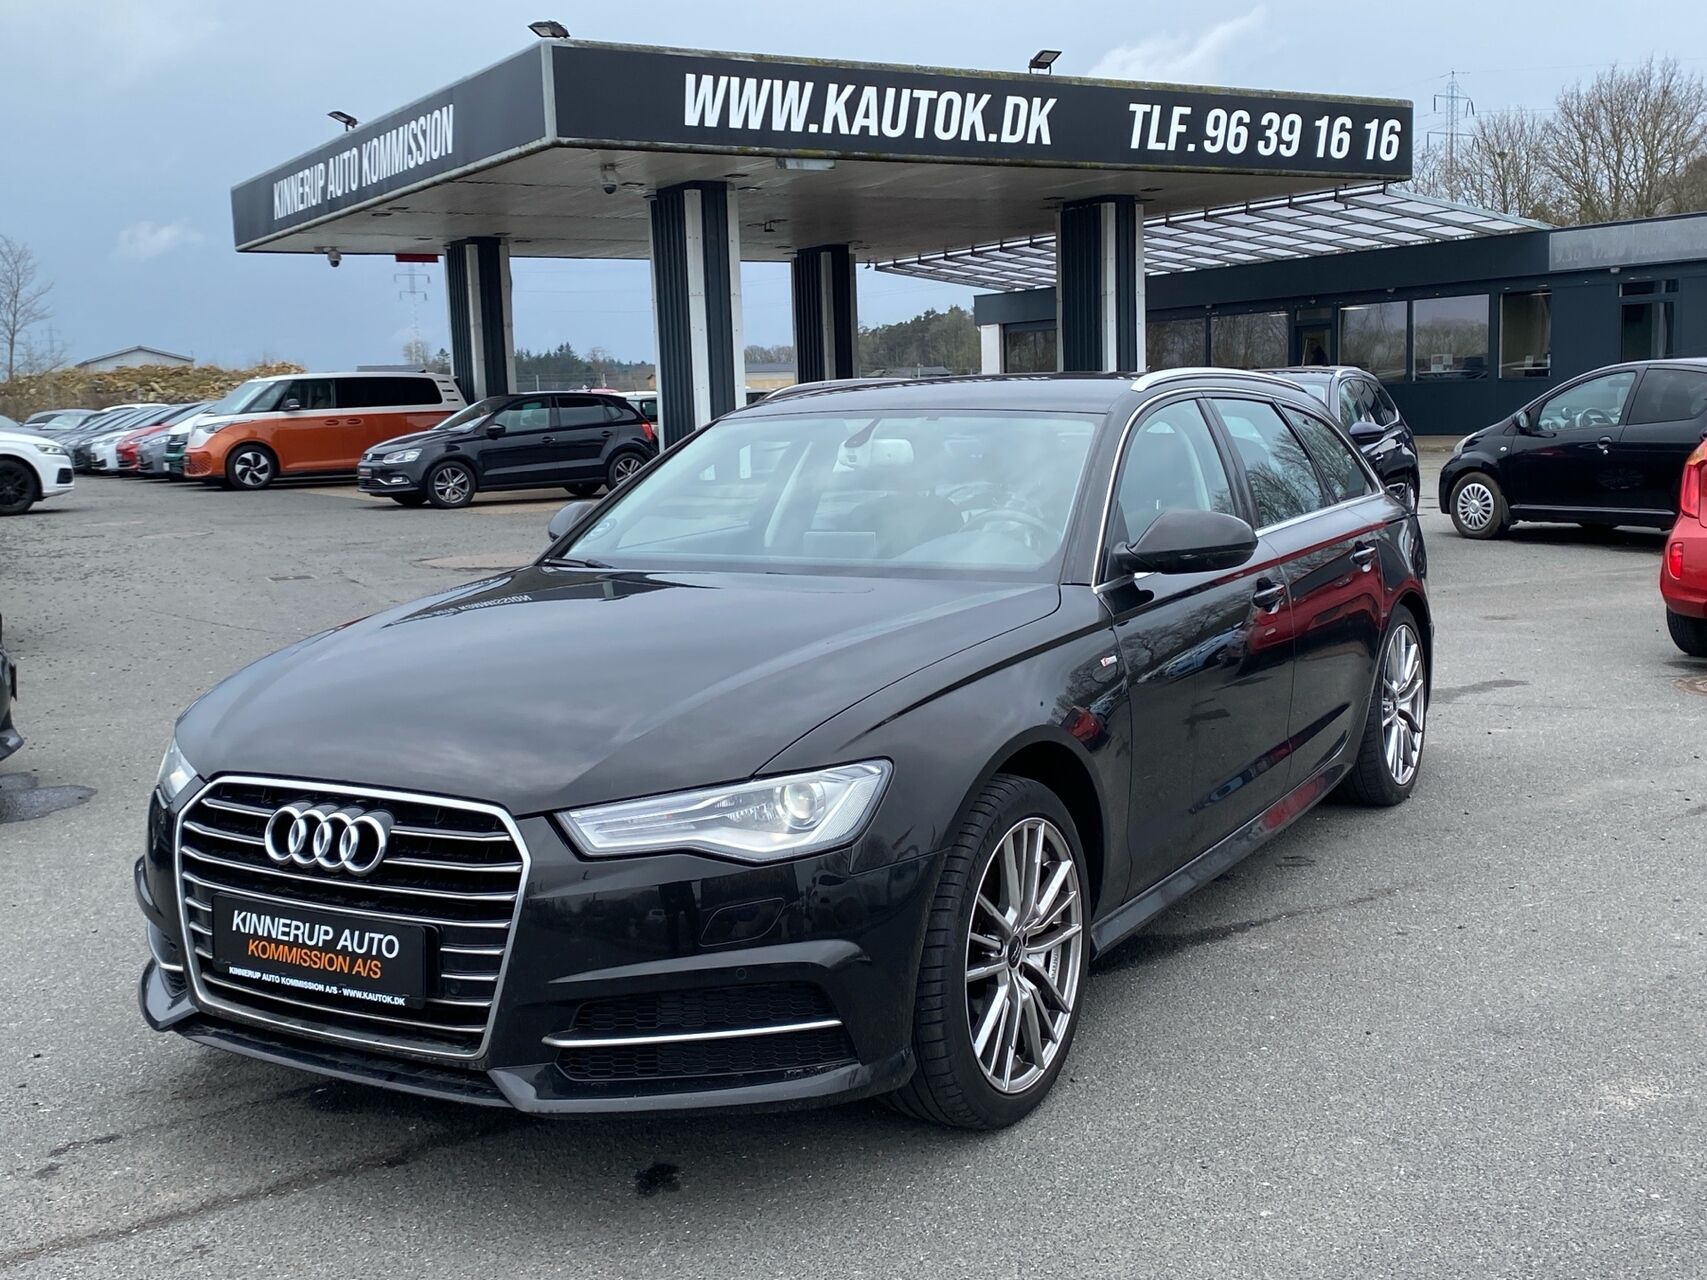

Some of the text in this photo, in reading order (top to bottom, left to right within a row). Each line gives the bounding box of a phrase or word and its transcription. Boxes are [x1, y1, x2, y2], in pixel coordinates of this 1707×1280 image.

[684, 72, 1058, 146] WWW.KAUTOK.DK
[1128, 103, 1402, 162] TLF. 96 39 16 16
[273, 104, 455, 220] KINNERUP AUTO KOMMISSION
[231, 910, 400, 960] KINNERUP AUTO
[247, 939, 383, 980] KOMMISSION A/S
[228, 966, 262, 980] KINNERUP
[262, 973, 280, 984] AUTO
[281, 976, 325, 992] KOMMISSION
[325, 985, 338, 995] A/S
